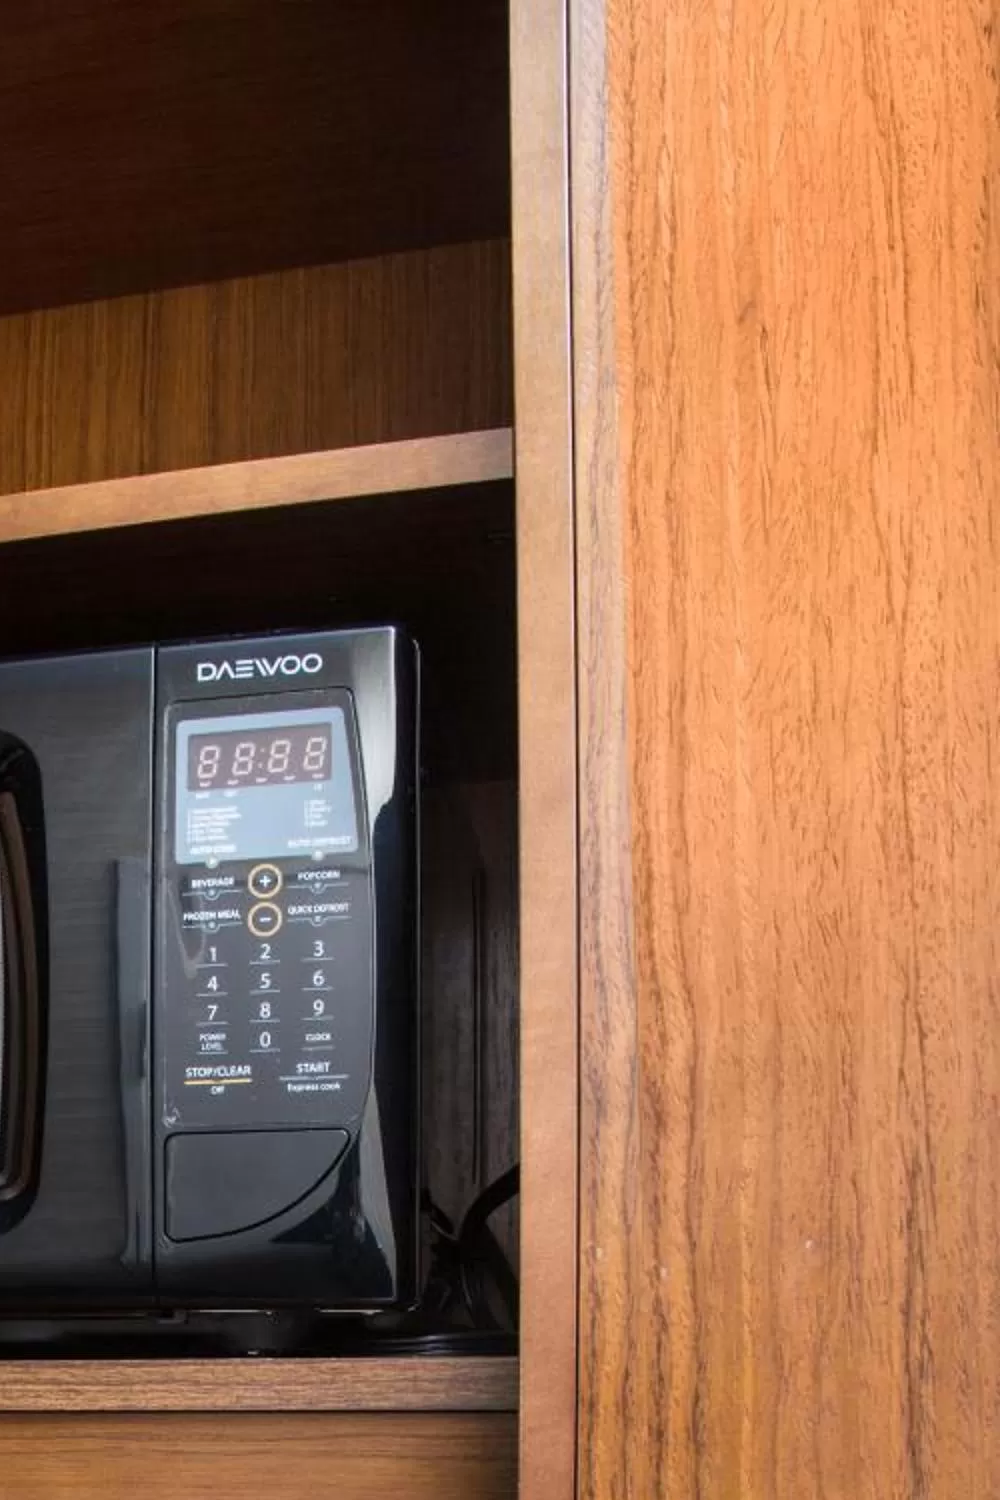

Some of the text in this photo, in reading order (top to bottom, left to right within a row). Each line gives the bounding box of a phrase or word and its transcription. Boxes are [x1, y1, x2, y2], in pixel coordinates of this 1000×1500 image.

[197, 653, 323, 682] DAEWOO
[298, 870, 340, 881] POPCORN
[287, 905, 313, 915] QUICK
[210, 946, 217, 962] 1
[260, 943, 271, 959] 2
[313, 940, 325, 957] 3
[207, 976, 218, 991] 4
[260, 973, 271, 989] 5
[313, 970, 325, 986] 6
[207, 1004, 218, 1020] 7
[260, 1002, 271, 1018] 8
[313, 999, 325, 1016] 9
[259, 1031, 271, 1048] 0
[305, 1033, 331, 1041] CLOCK
[185, 1065, 252, 1078] STOP/CLEAR
[296, 1062, 331, 1073] START
